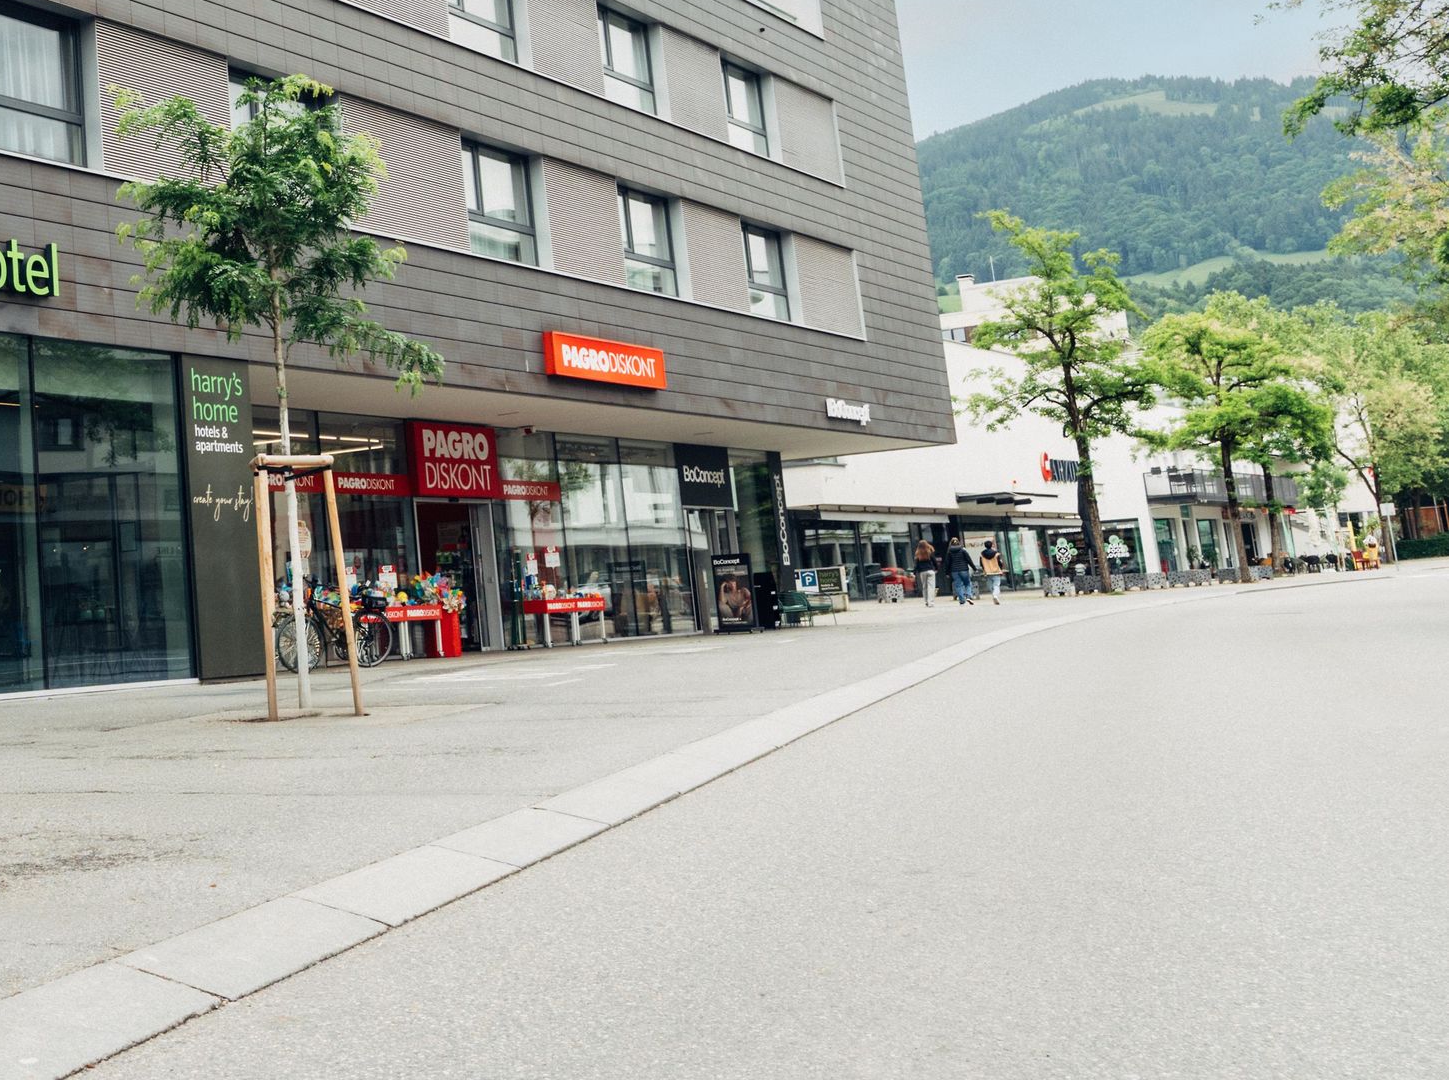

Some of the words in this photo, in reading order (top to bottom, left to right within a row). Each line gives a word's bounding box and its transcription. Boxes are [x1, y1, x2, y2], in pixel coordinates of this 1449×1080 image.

[561, 344, 655, 378] PAGRODISKONT
[191, 368, 243, 400] harry's
[193, 396, 239, 423] home
[194, 424, 221, 439] hotels
[221, 426, 229, 438] &
[422, 429, 489, 461] PAGRO
[195, 440, 244, 454] apartments
[338, 476, 395, 490] PAGRODISKONT
[425, 462, 491, 491] DISKONT
[503, 484, 548, 496] PAGRODISKONT
[683, 465, 725, 488] BoConcept
[193, 483, 213, 507] create
[215, 497, 233, 522] your
[773, 473, 790, 566] BoConcept
